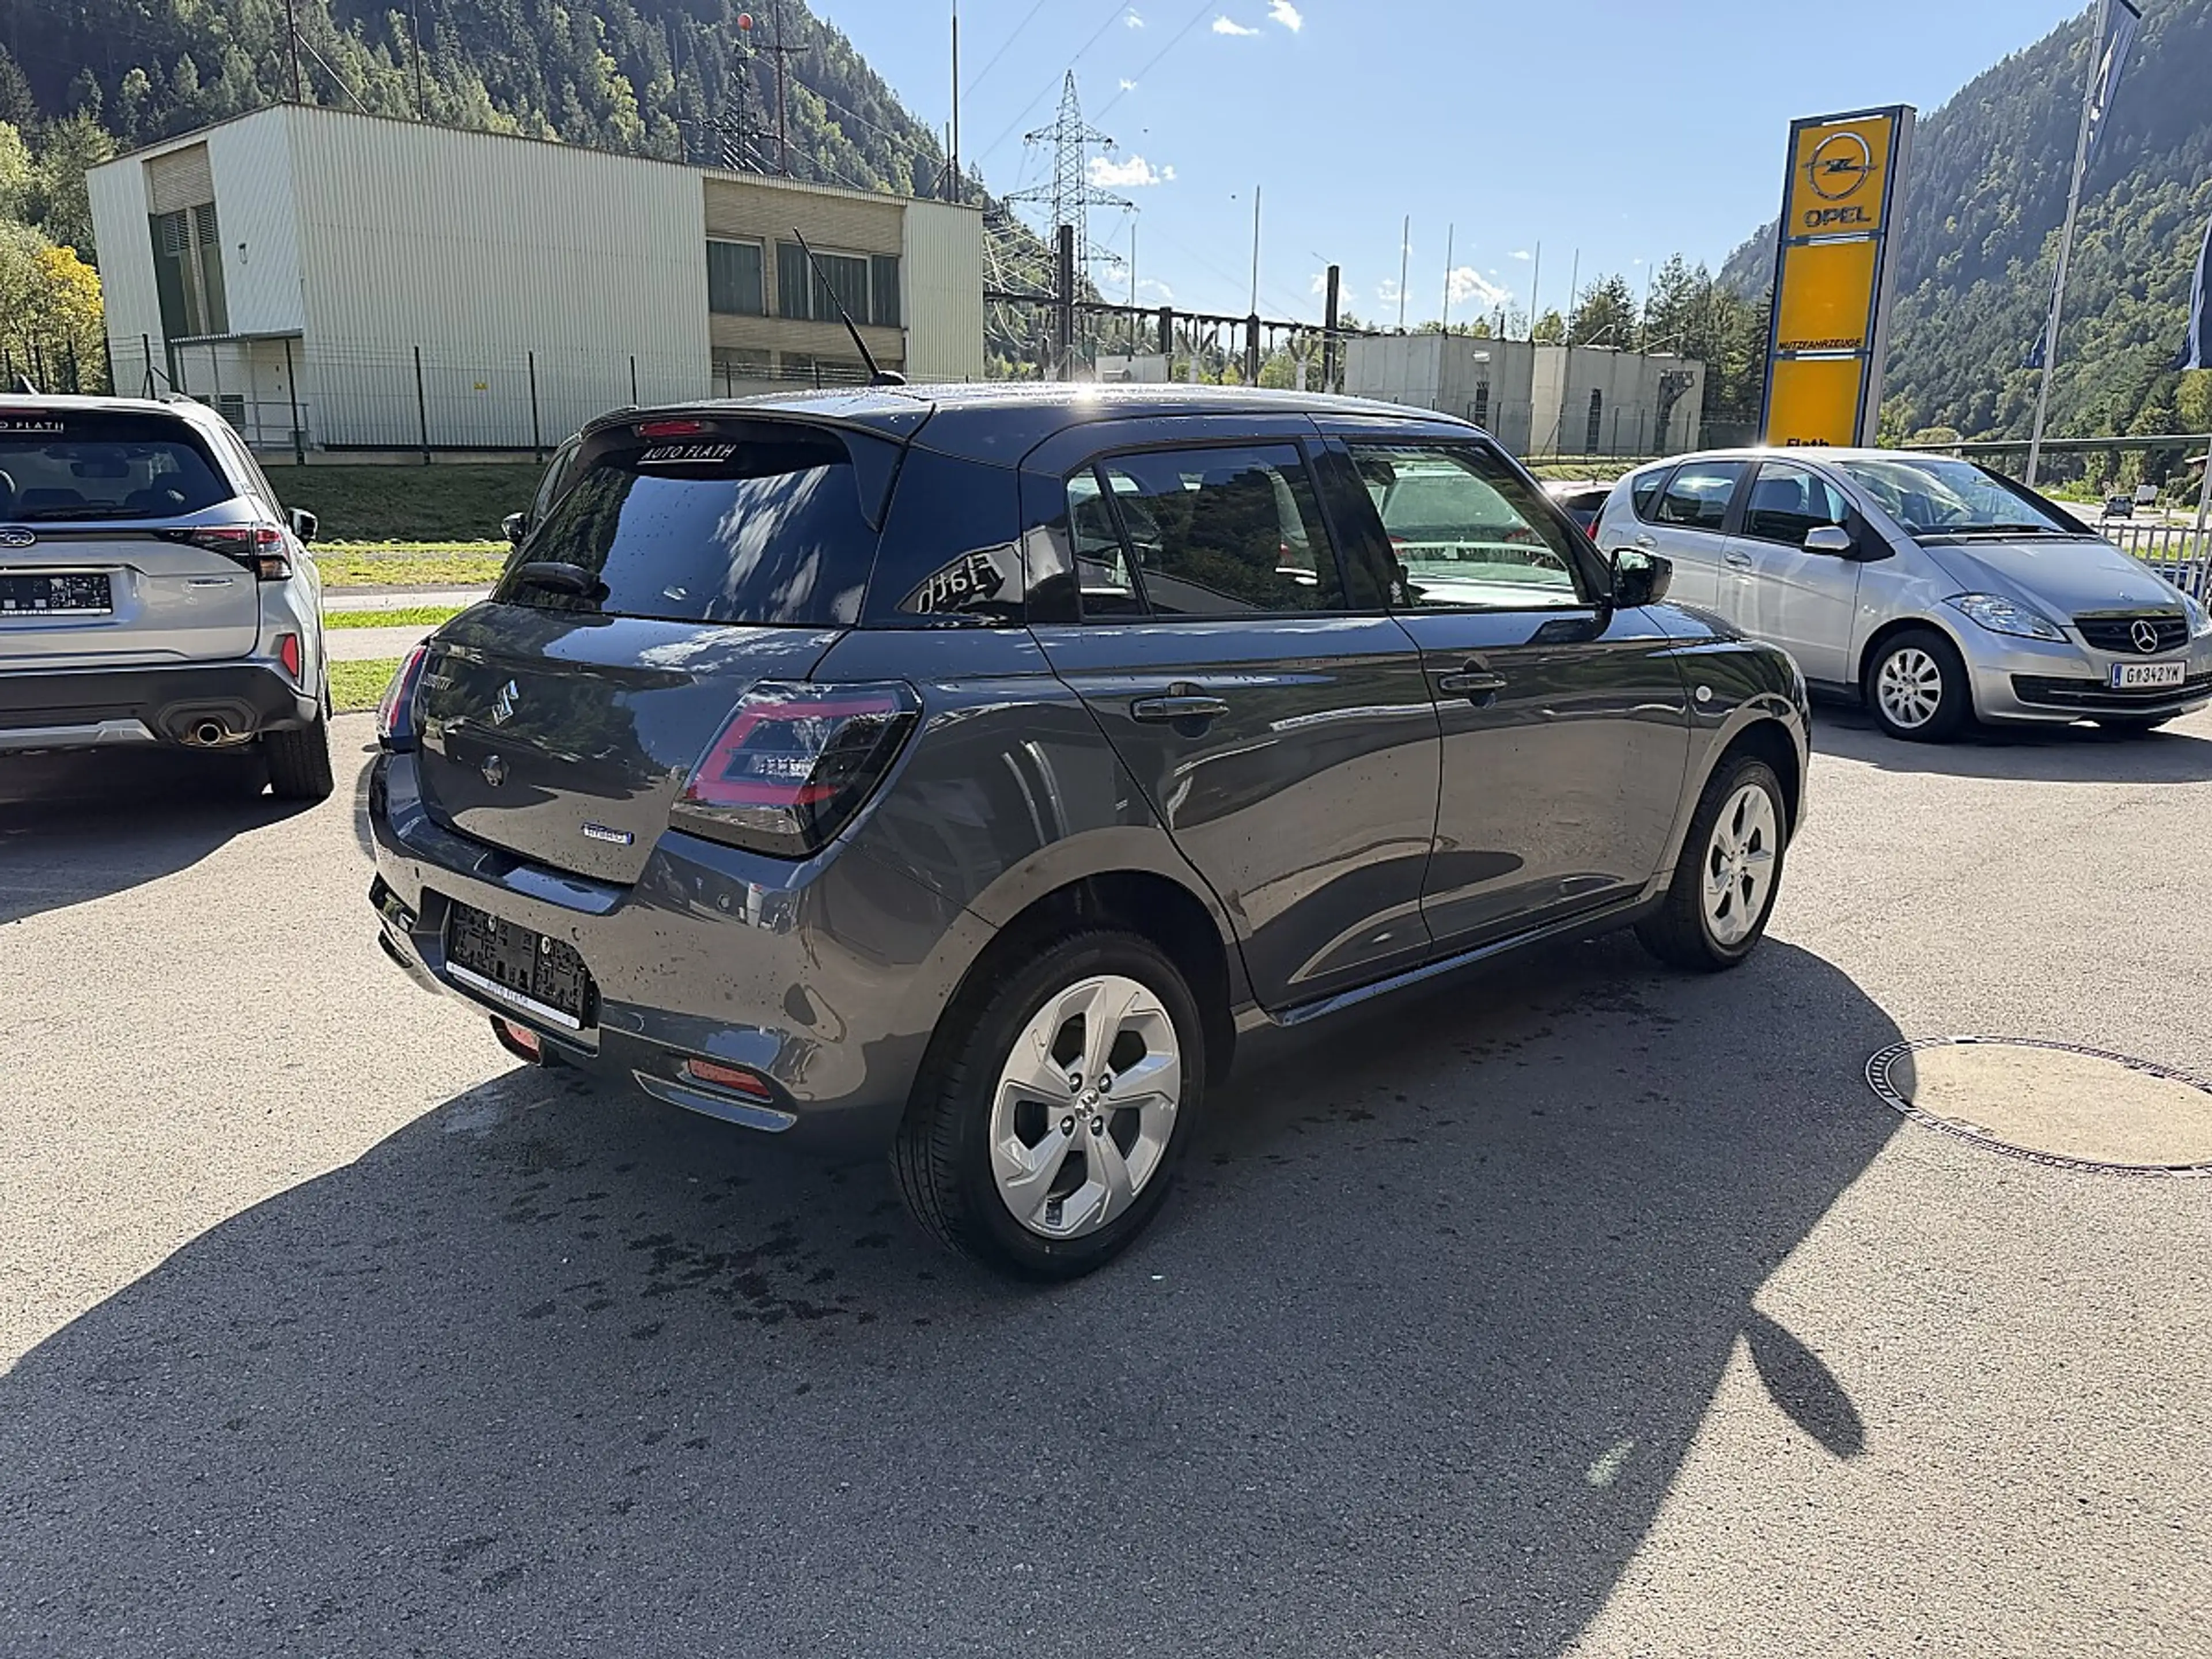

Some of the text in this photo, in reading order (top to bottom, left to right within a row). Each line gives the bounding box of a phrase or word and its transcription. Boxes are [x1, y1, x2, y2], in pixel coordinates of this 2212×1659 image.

[1804, 206, 1872, 228] OPEL
[1778, 338, 1862, 350] NUTZFAHRZEUGE
[641, 444, 737, 460] AUTO FLATH
